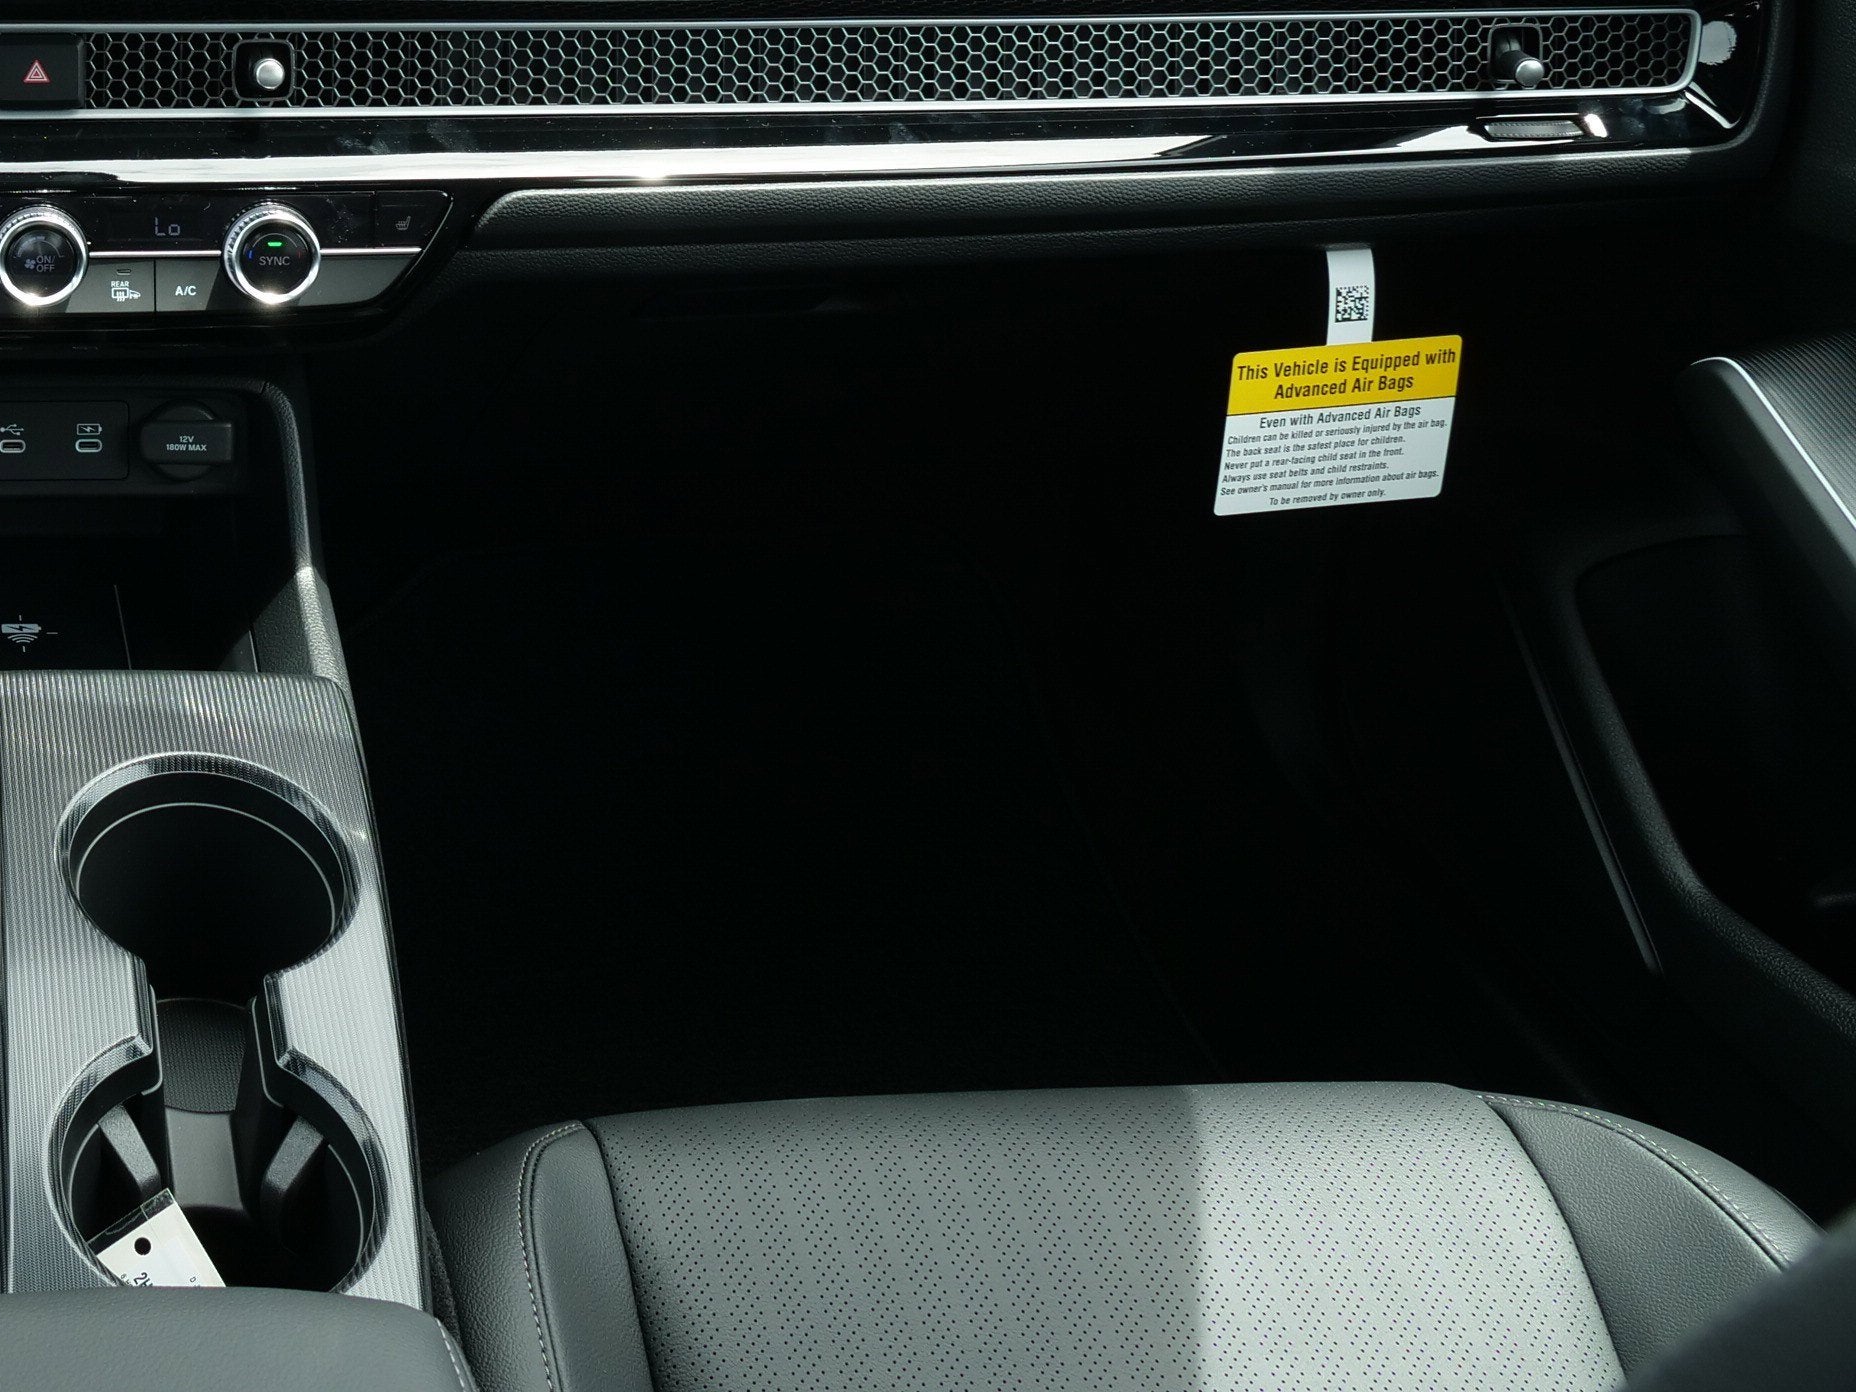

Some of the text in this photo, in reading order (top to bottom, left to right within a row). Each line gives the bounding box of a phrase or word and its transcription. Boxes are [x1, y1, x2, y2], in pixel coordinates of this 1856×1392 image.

[154, 216, 180, 237] Lo
[36, 255, 56, 265] ON/
[36, 263, 55, 273] OFF
[258, 255, 291, 266] SYNC
[110, 280, 130, 288] REAR
[174, 285, 197, 296] A/C
[1238, 349, 1456, 381] This Vehicle is Equipped with
[1274, 376, 1414, 399] Advanced Air Bags
[1260, 406, 1421, 428] Even with Advanced Air Bags
[179, 435, 194, 443] 12V
[1228, 435, 1261, 445] Children
[1263, 433, 1277, 442] can
[1279, 432, 1289, 440] be
[1291, 430, 1313, 439] killed
[1325, 426, 1360, 437] seriously
[1362, 423, 1390, 434] injured
[1404, 420, 1415, 429] the
[1417, 419, 1429, 428] air
[166, 443, 187, 451] 180W
[1226, 449, 1240, 458] The
[1243, 448, 1262, 456] back
[1264, 446, 1281, 455] seat
[1292, 444, 1305, 452] the
[1307, 441, 1332, 451] safest
[1334, 440, 1355, 450] place
[1357, 437, 1368, 446] for
[1224, 462, 1248, 471] Never
[1250, 460, 1263, 469] put
[1272, 455, 1316, 467] rear-facing
[1318, 453, 1338, 463] child
[1339, 452, 1357, 461] seat
[1368, 449, 1381, 458] the
[1220, 487, 1236, 496] See
[1269, 481, 1299, 492] manual
[1300, 480, 1312, 489] for
[1313, 479, 1333, 488] more
[1335, 474, 1381, 485] information
[1382, 472, 1404, 481] about
[1405, 471, 1416, 480] air
[1222, 474, 1251, 484] Always
[1253, 472, 1267, 481] use
[1269, 470, 1287, 479] seat
[1289, 468, 1308, 477] belts
[1310, 467, 1325, 476] and
[1327, 465, 1347, 474] child
[1269, 497, 1279, 506] To
[1281, 496, 1291, 504] be
[1292, 493, 1327, 504] removed
[1329, 492, 1339, 502] by
[1340, 489, 1365, 500] owner
